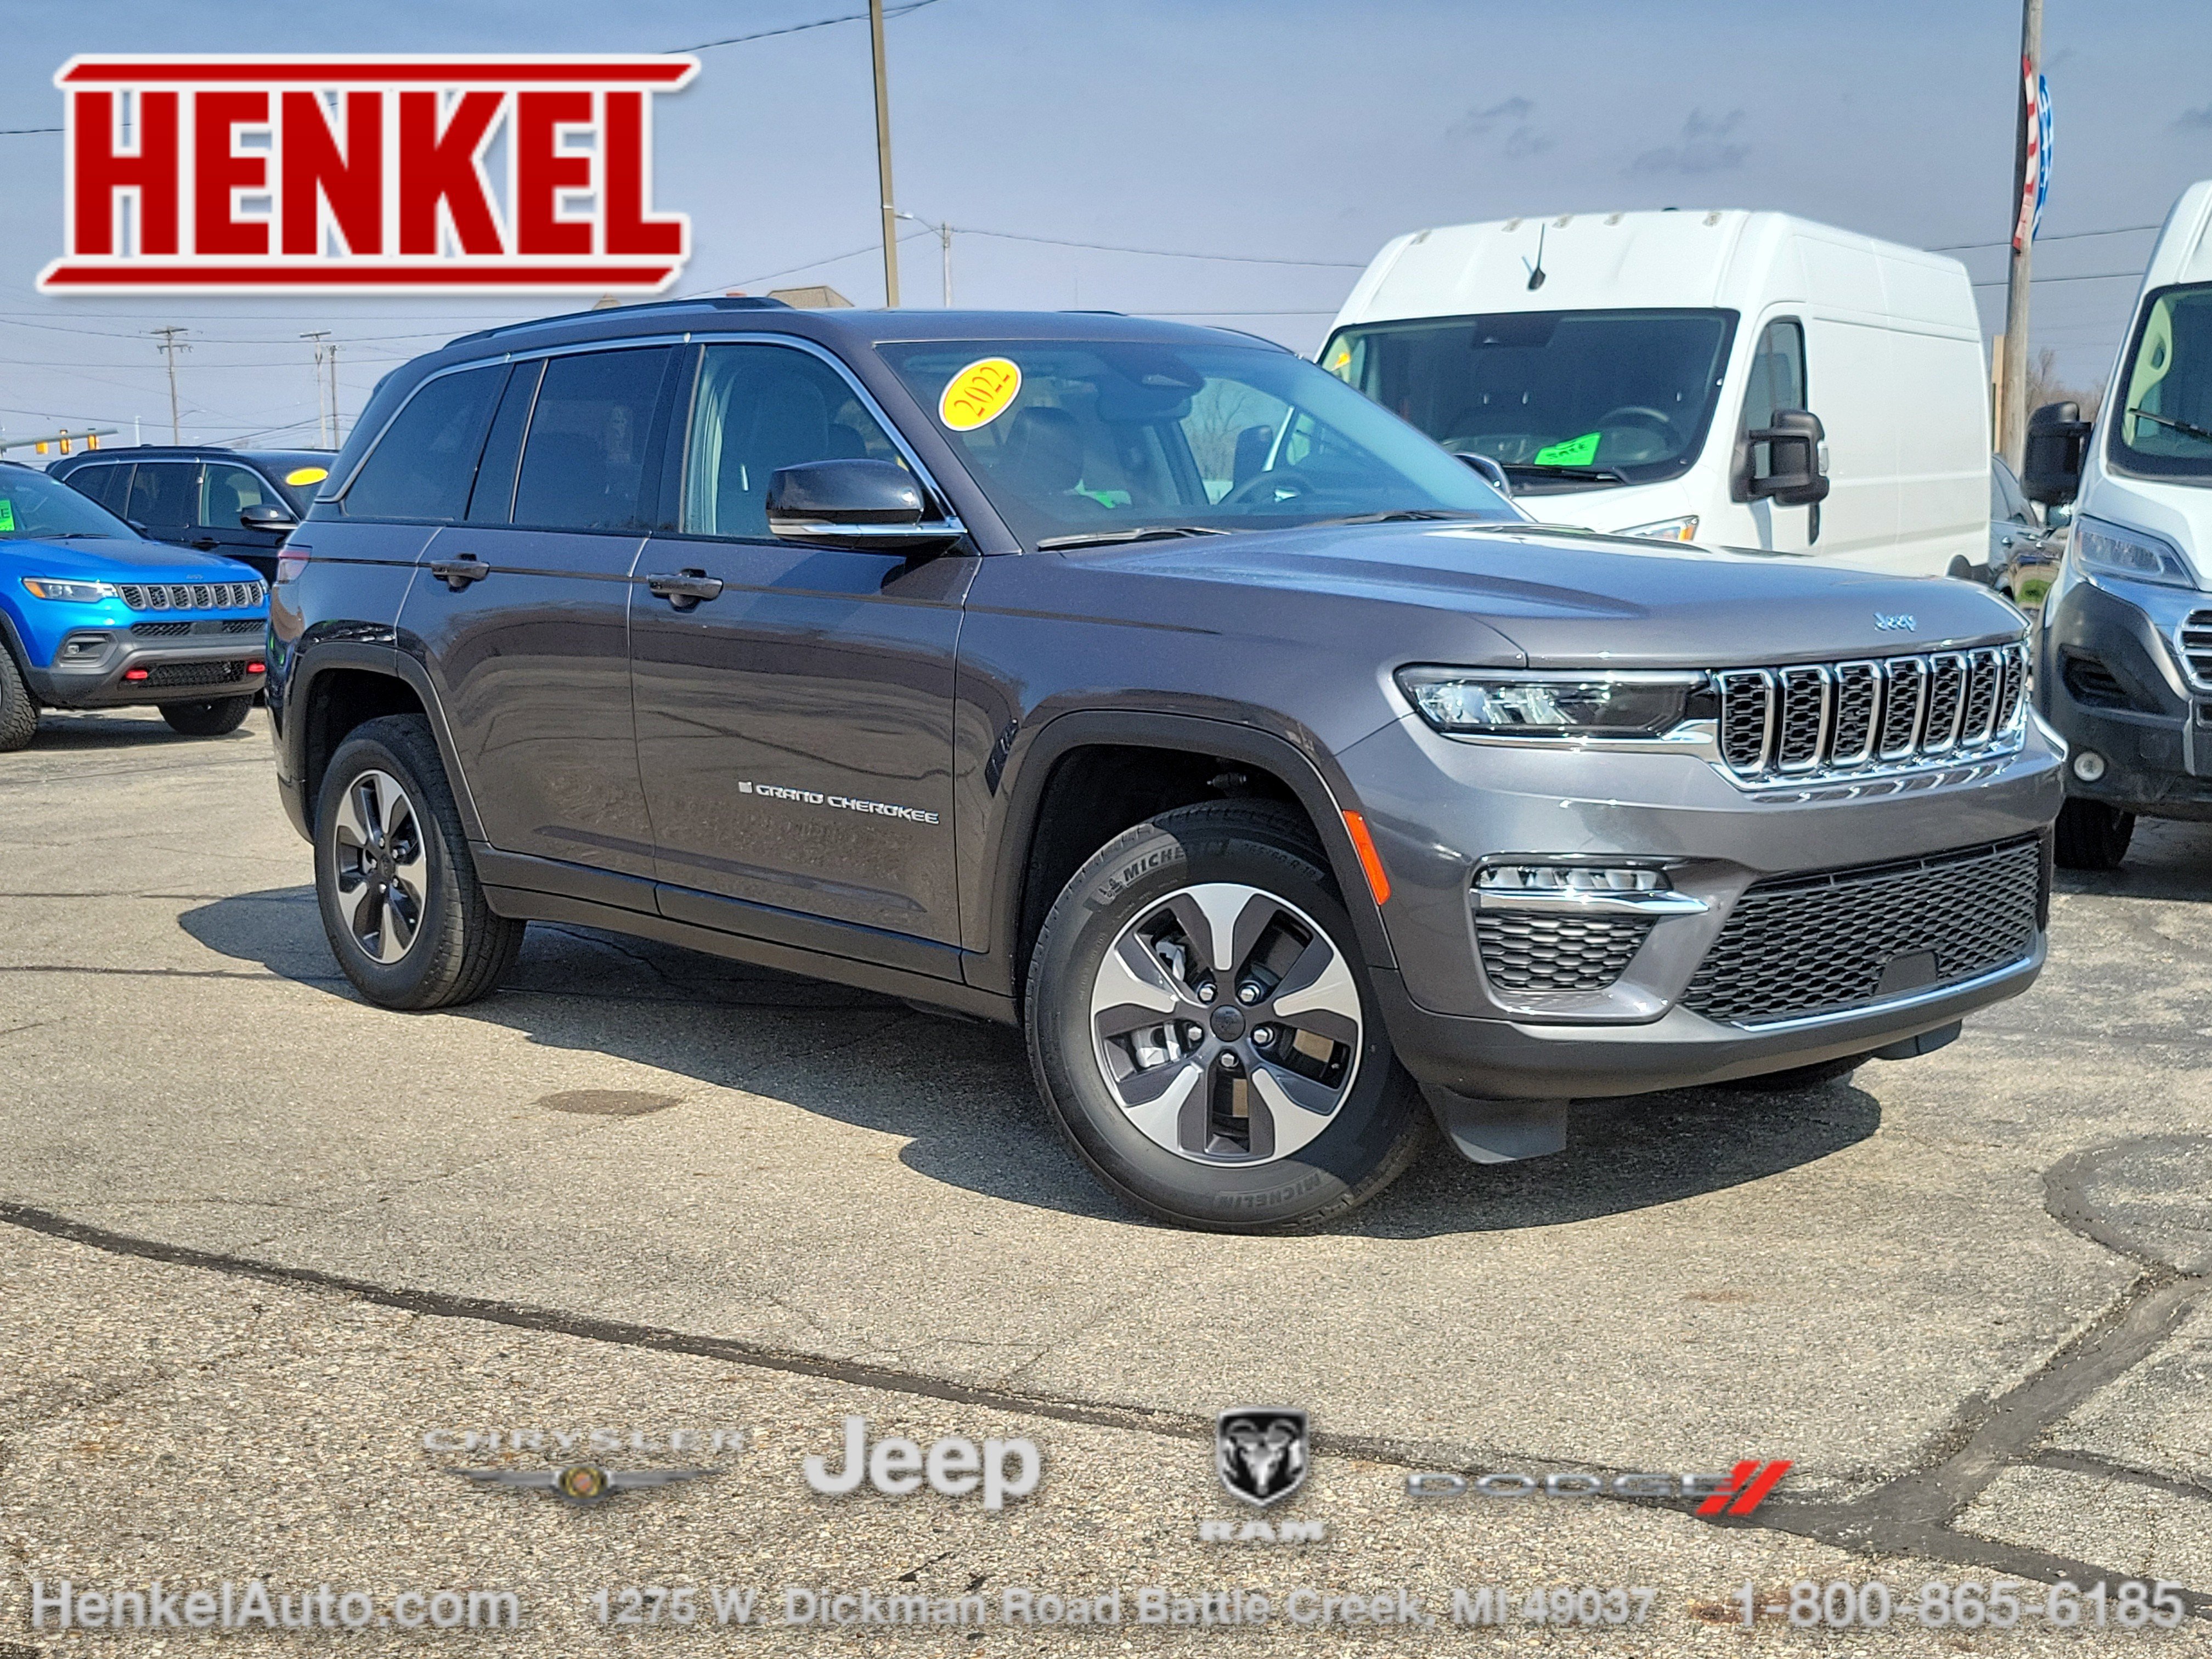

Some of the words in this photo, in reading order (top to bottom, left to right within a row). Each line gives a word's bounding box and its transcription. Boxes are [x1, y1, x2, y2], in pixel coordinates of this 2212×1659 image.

[953, 366, 1011, 417] 2022
[1873, 612, 1916, 633] Jeep
[755, 784, 824, 805] GRAND
[827, 795, 940, 825] CHEROKEE
